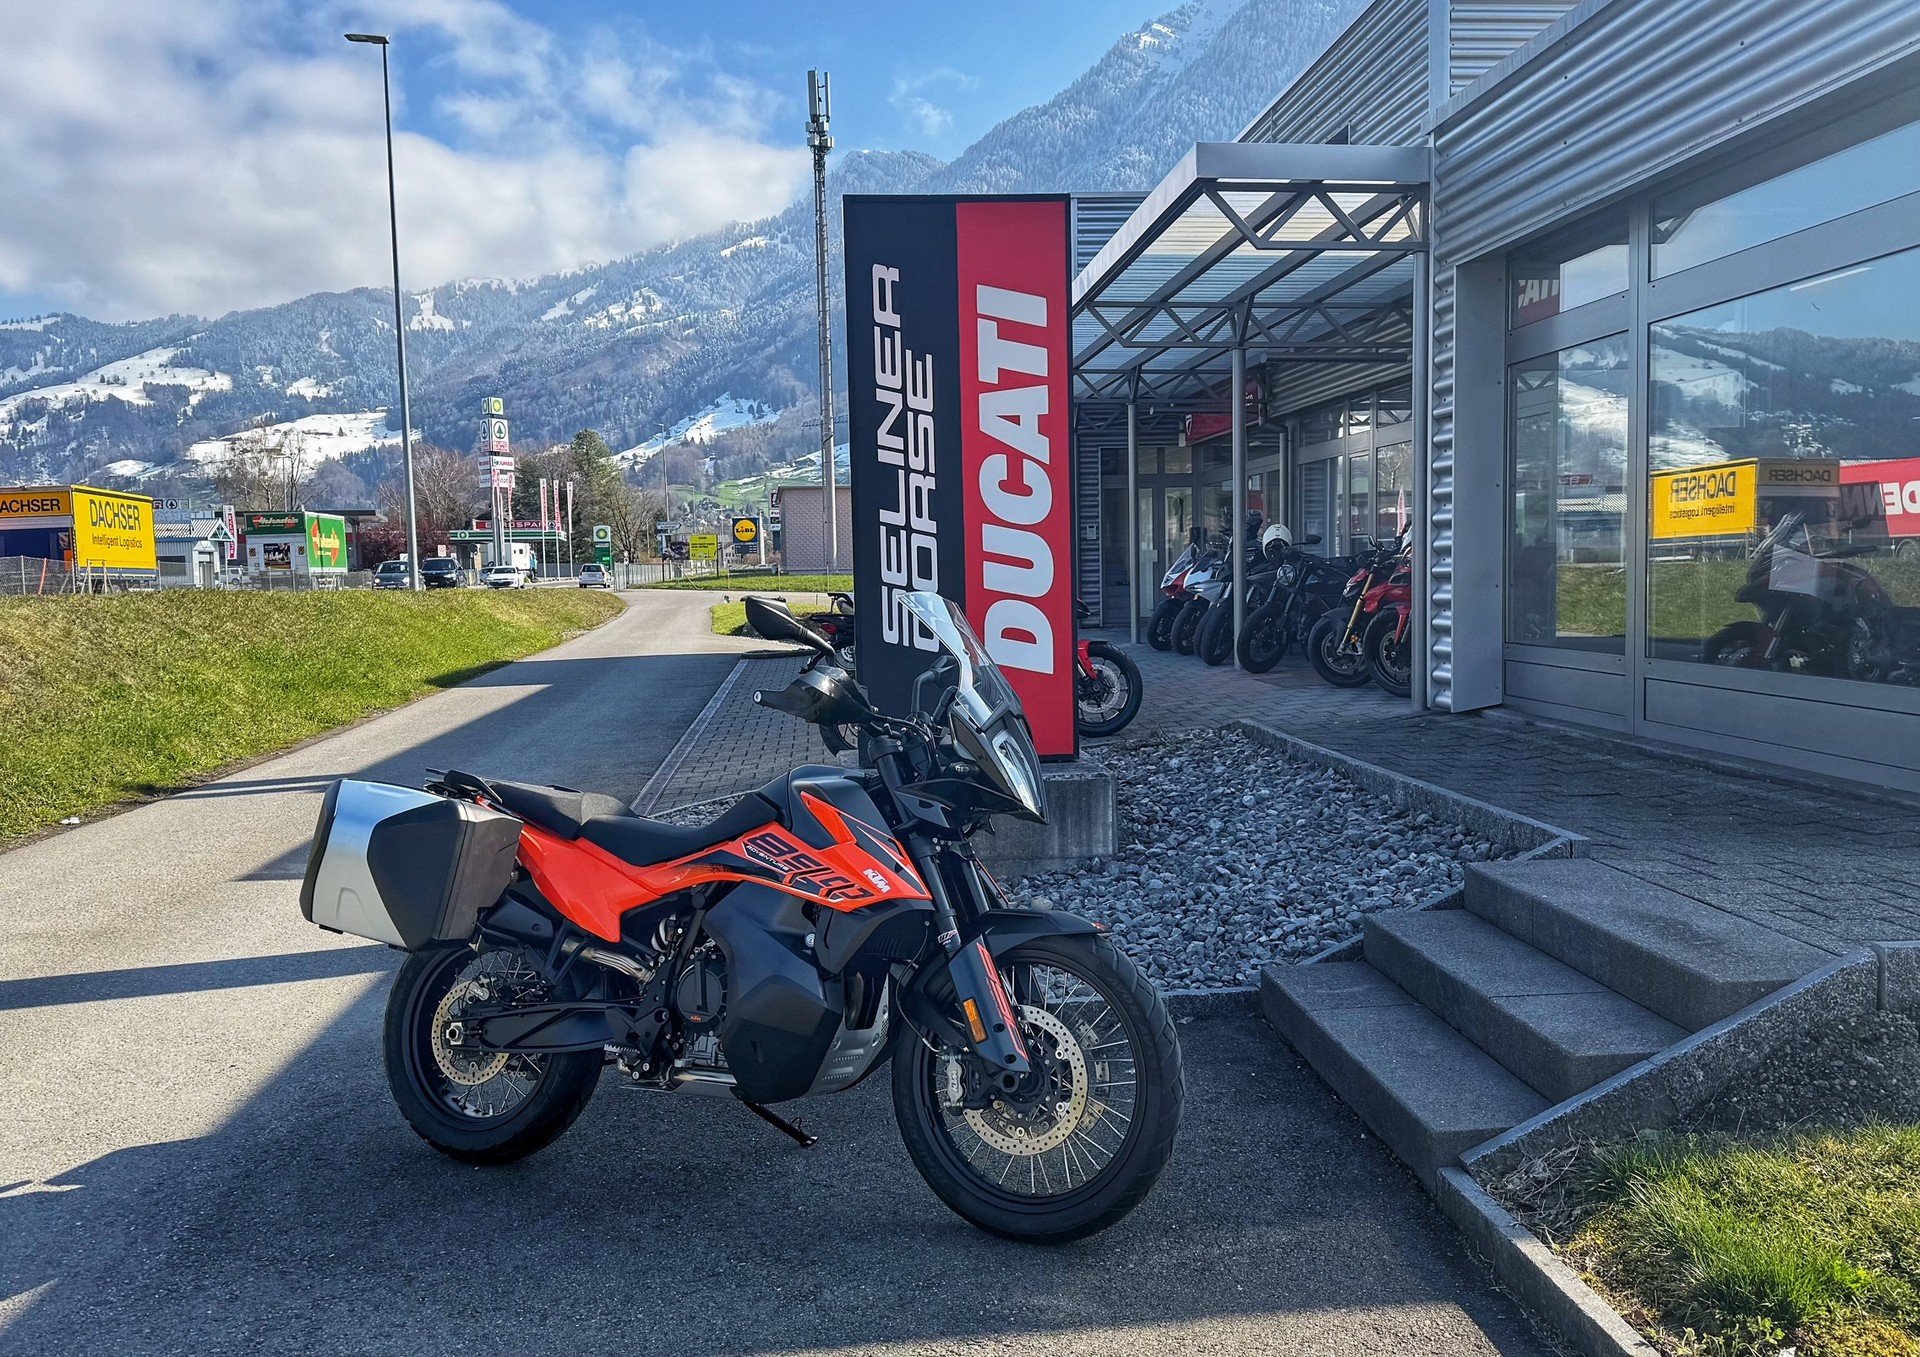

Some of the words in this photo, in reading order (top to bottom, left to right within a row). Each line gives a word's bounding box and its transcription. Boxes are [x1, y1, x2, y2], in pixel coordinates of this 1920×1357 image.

[872, 263, 909, 647] SELINER
[976, 284, 1055, 675] DUCATI
[0, 498, 61, 513] ACHSER
[89, 498, 141, 531] DACHSER
[485, 521, 543, 529] EROSPAR
[91, 533, 119, 549] Intelligent
[119, 536, 143, 550] Logistics
[745, 844, 790, 872] ADVENTURE
[863, 868, 891, 893] KTM
[951, 1070, 959, 1093] KTM
